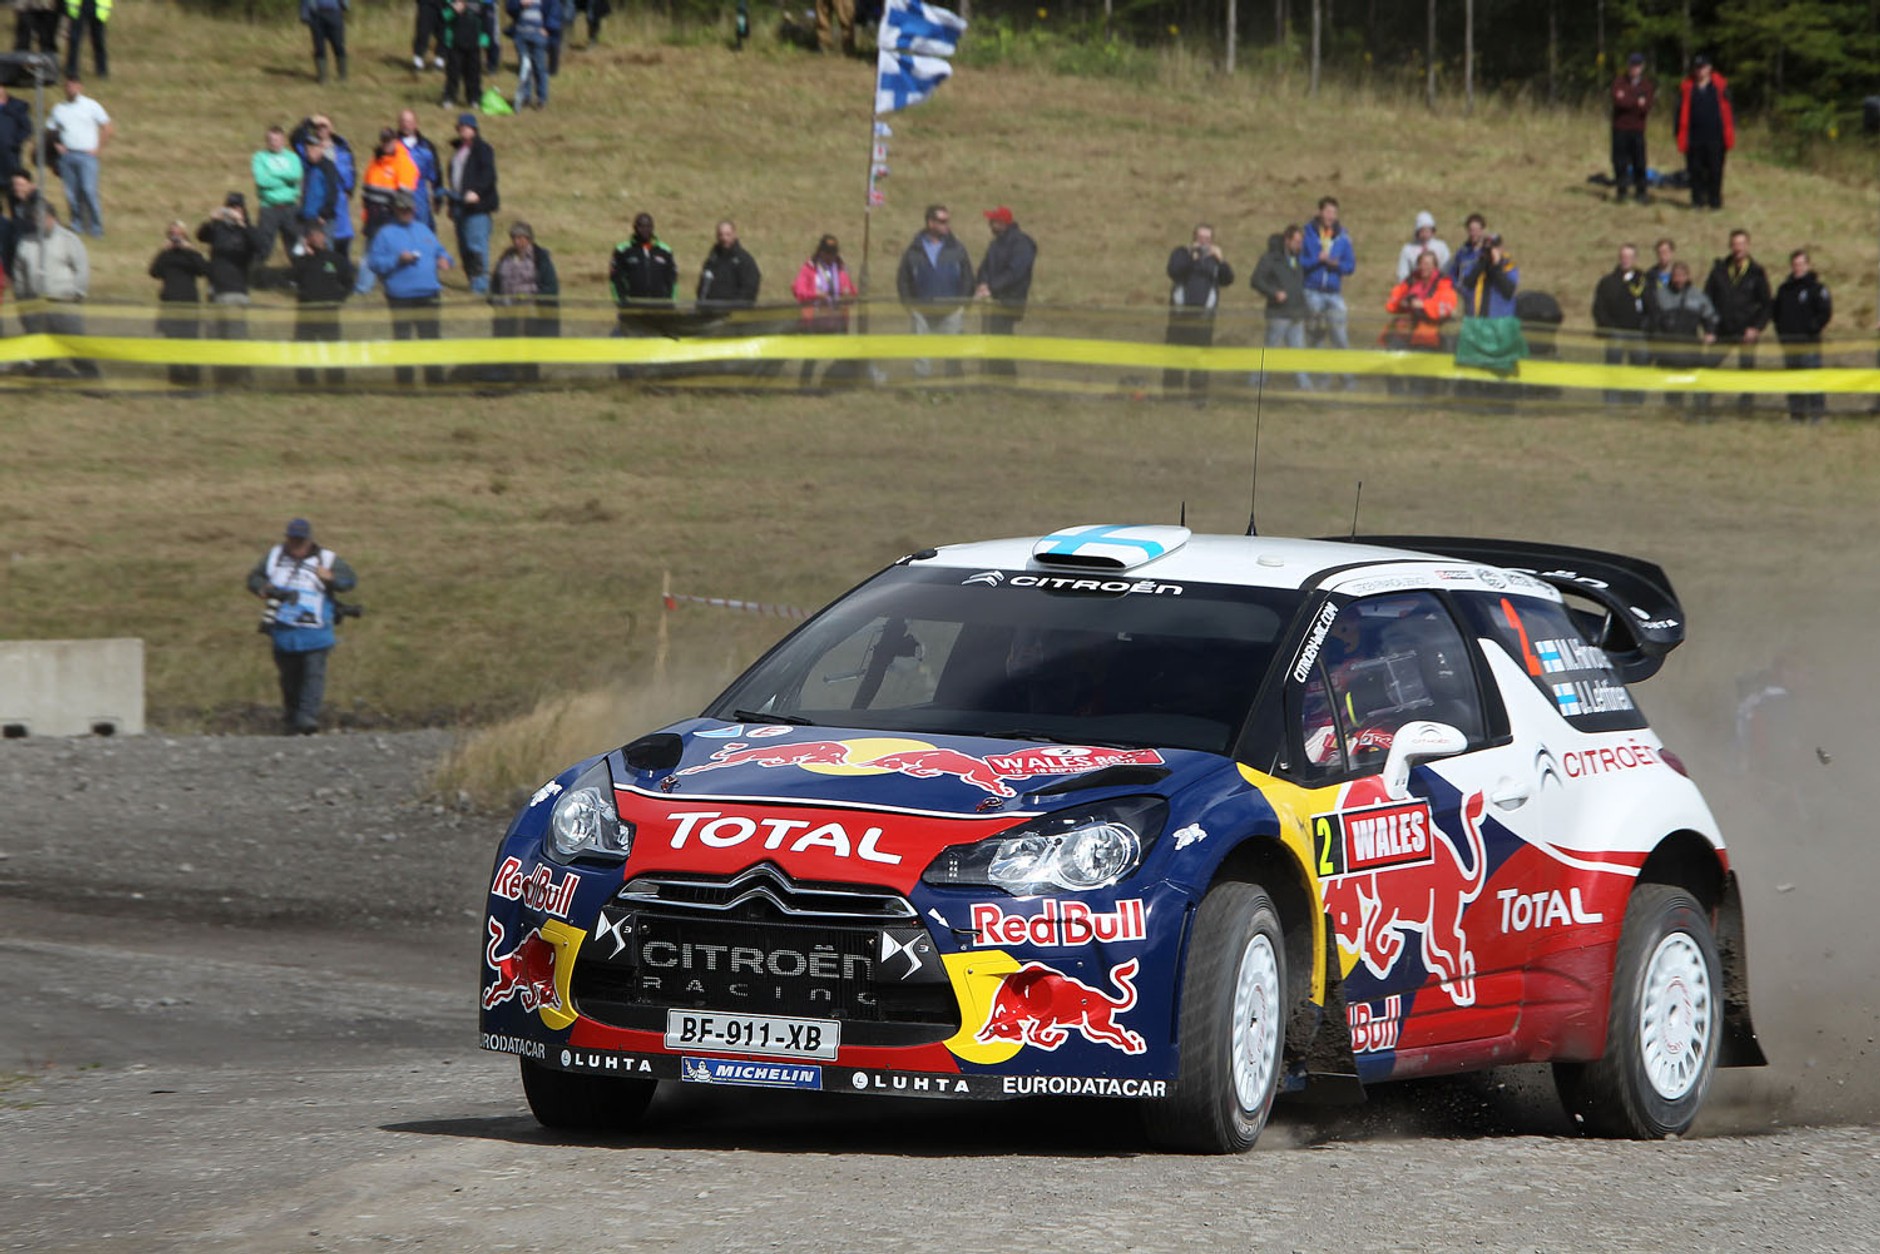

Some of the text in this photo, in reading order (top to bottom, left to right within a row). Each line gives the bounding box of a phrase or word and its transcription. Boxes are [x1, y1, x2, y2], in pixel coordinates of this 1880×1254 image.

[1010, 576, 1183, 597] CITROËN
[992, 756, 1090, 770] WALES
[667, 811, 903, 865] TOTAL
[1317, 811, 1427, 875] 2 WALES
[1058, 898, 1146, 946] Bull
[1498, 887, 1602, 934] TOTAL
[642, 941, 875, 980] CITROËN
[680, 1018, 822, 1050] BF-911-XB
[1351, 995, 1401, 1053] Bull
[480, 1032, 546, 1060] RODATACAR
[575, 1058, 652, 1074] LUHTA
[715, 1064, 816, 1083] MICHELIN
[874, 1079, 970, 1094] LUHTA
[1002, 1077, 1167, 1097] EURODATACAR
